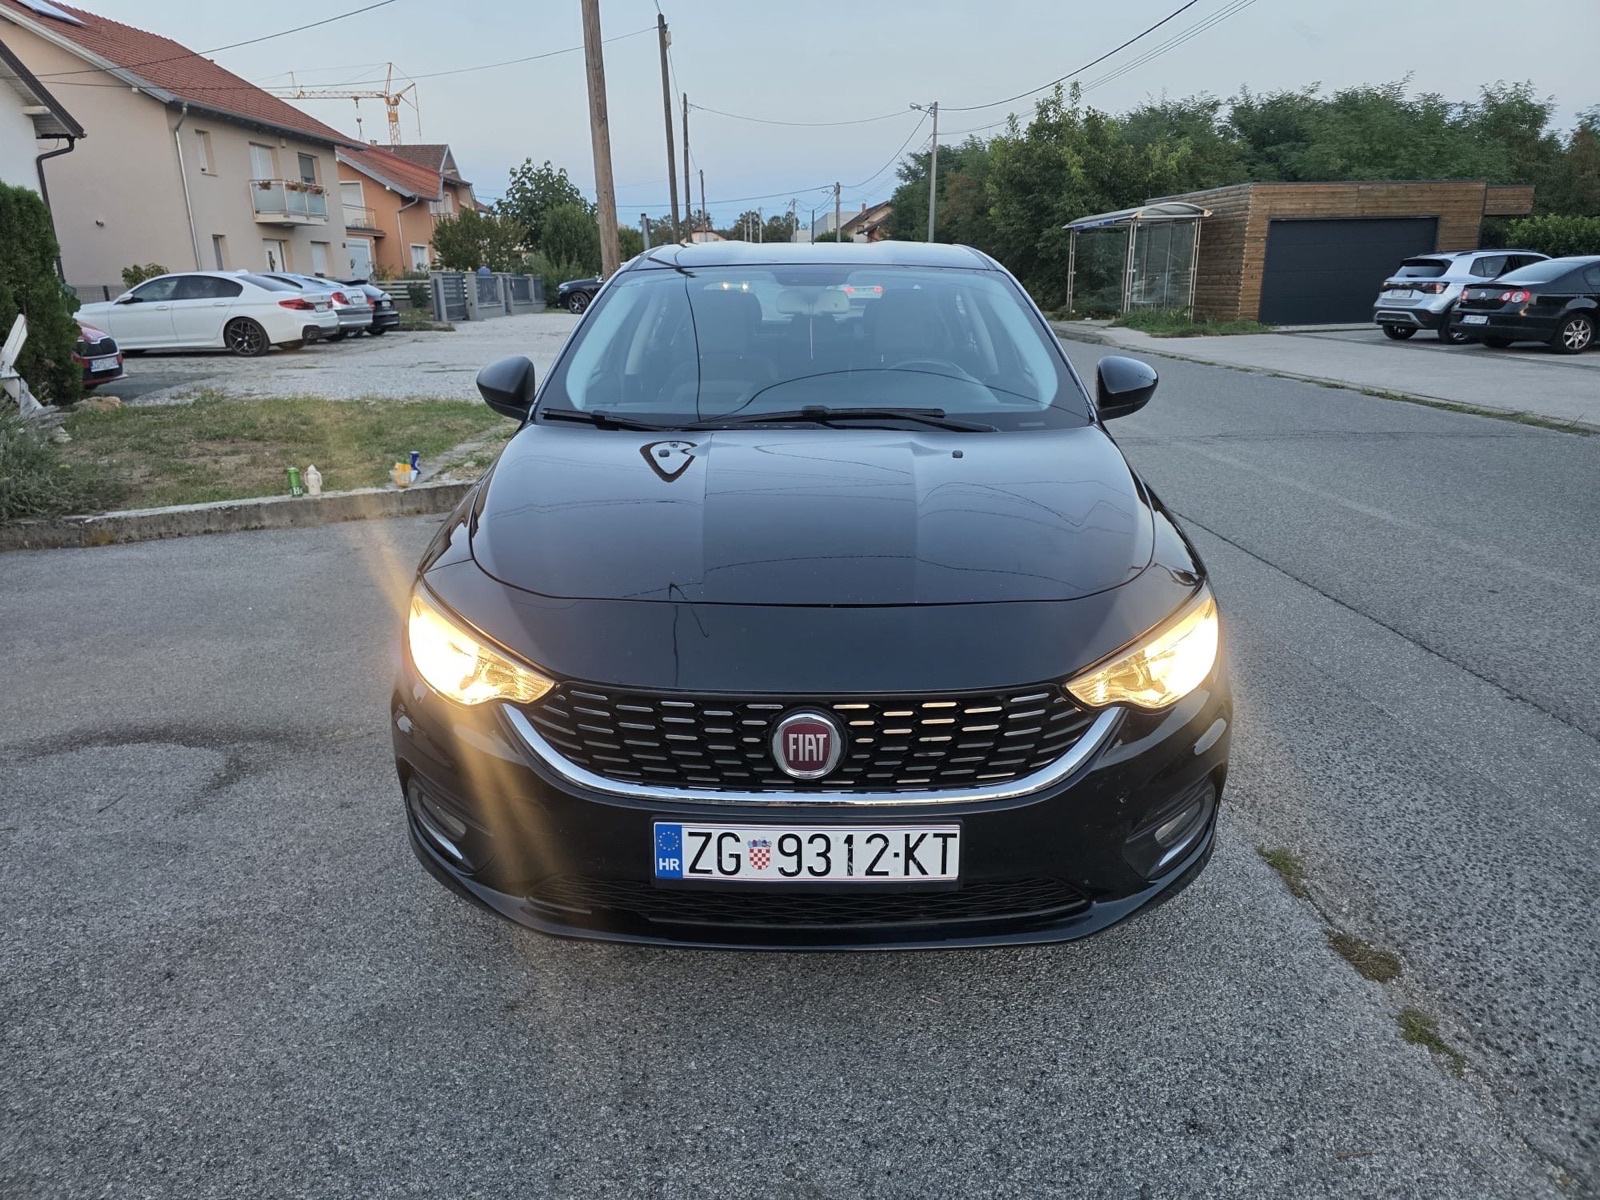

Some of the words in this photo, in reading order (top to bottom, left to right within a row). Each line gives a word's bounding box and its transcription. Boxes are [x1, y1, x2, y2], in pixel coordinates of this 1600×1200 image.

[789, 733, 827, 762] FIAT
[658, 857, 680, 871] HR
[687, 831, 741, 876] ZG
